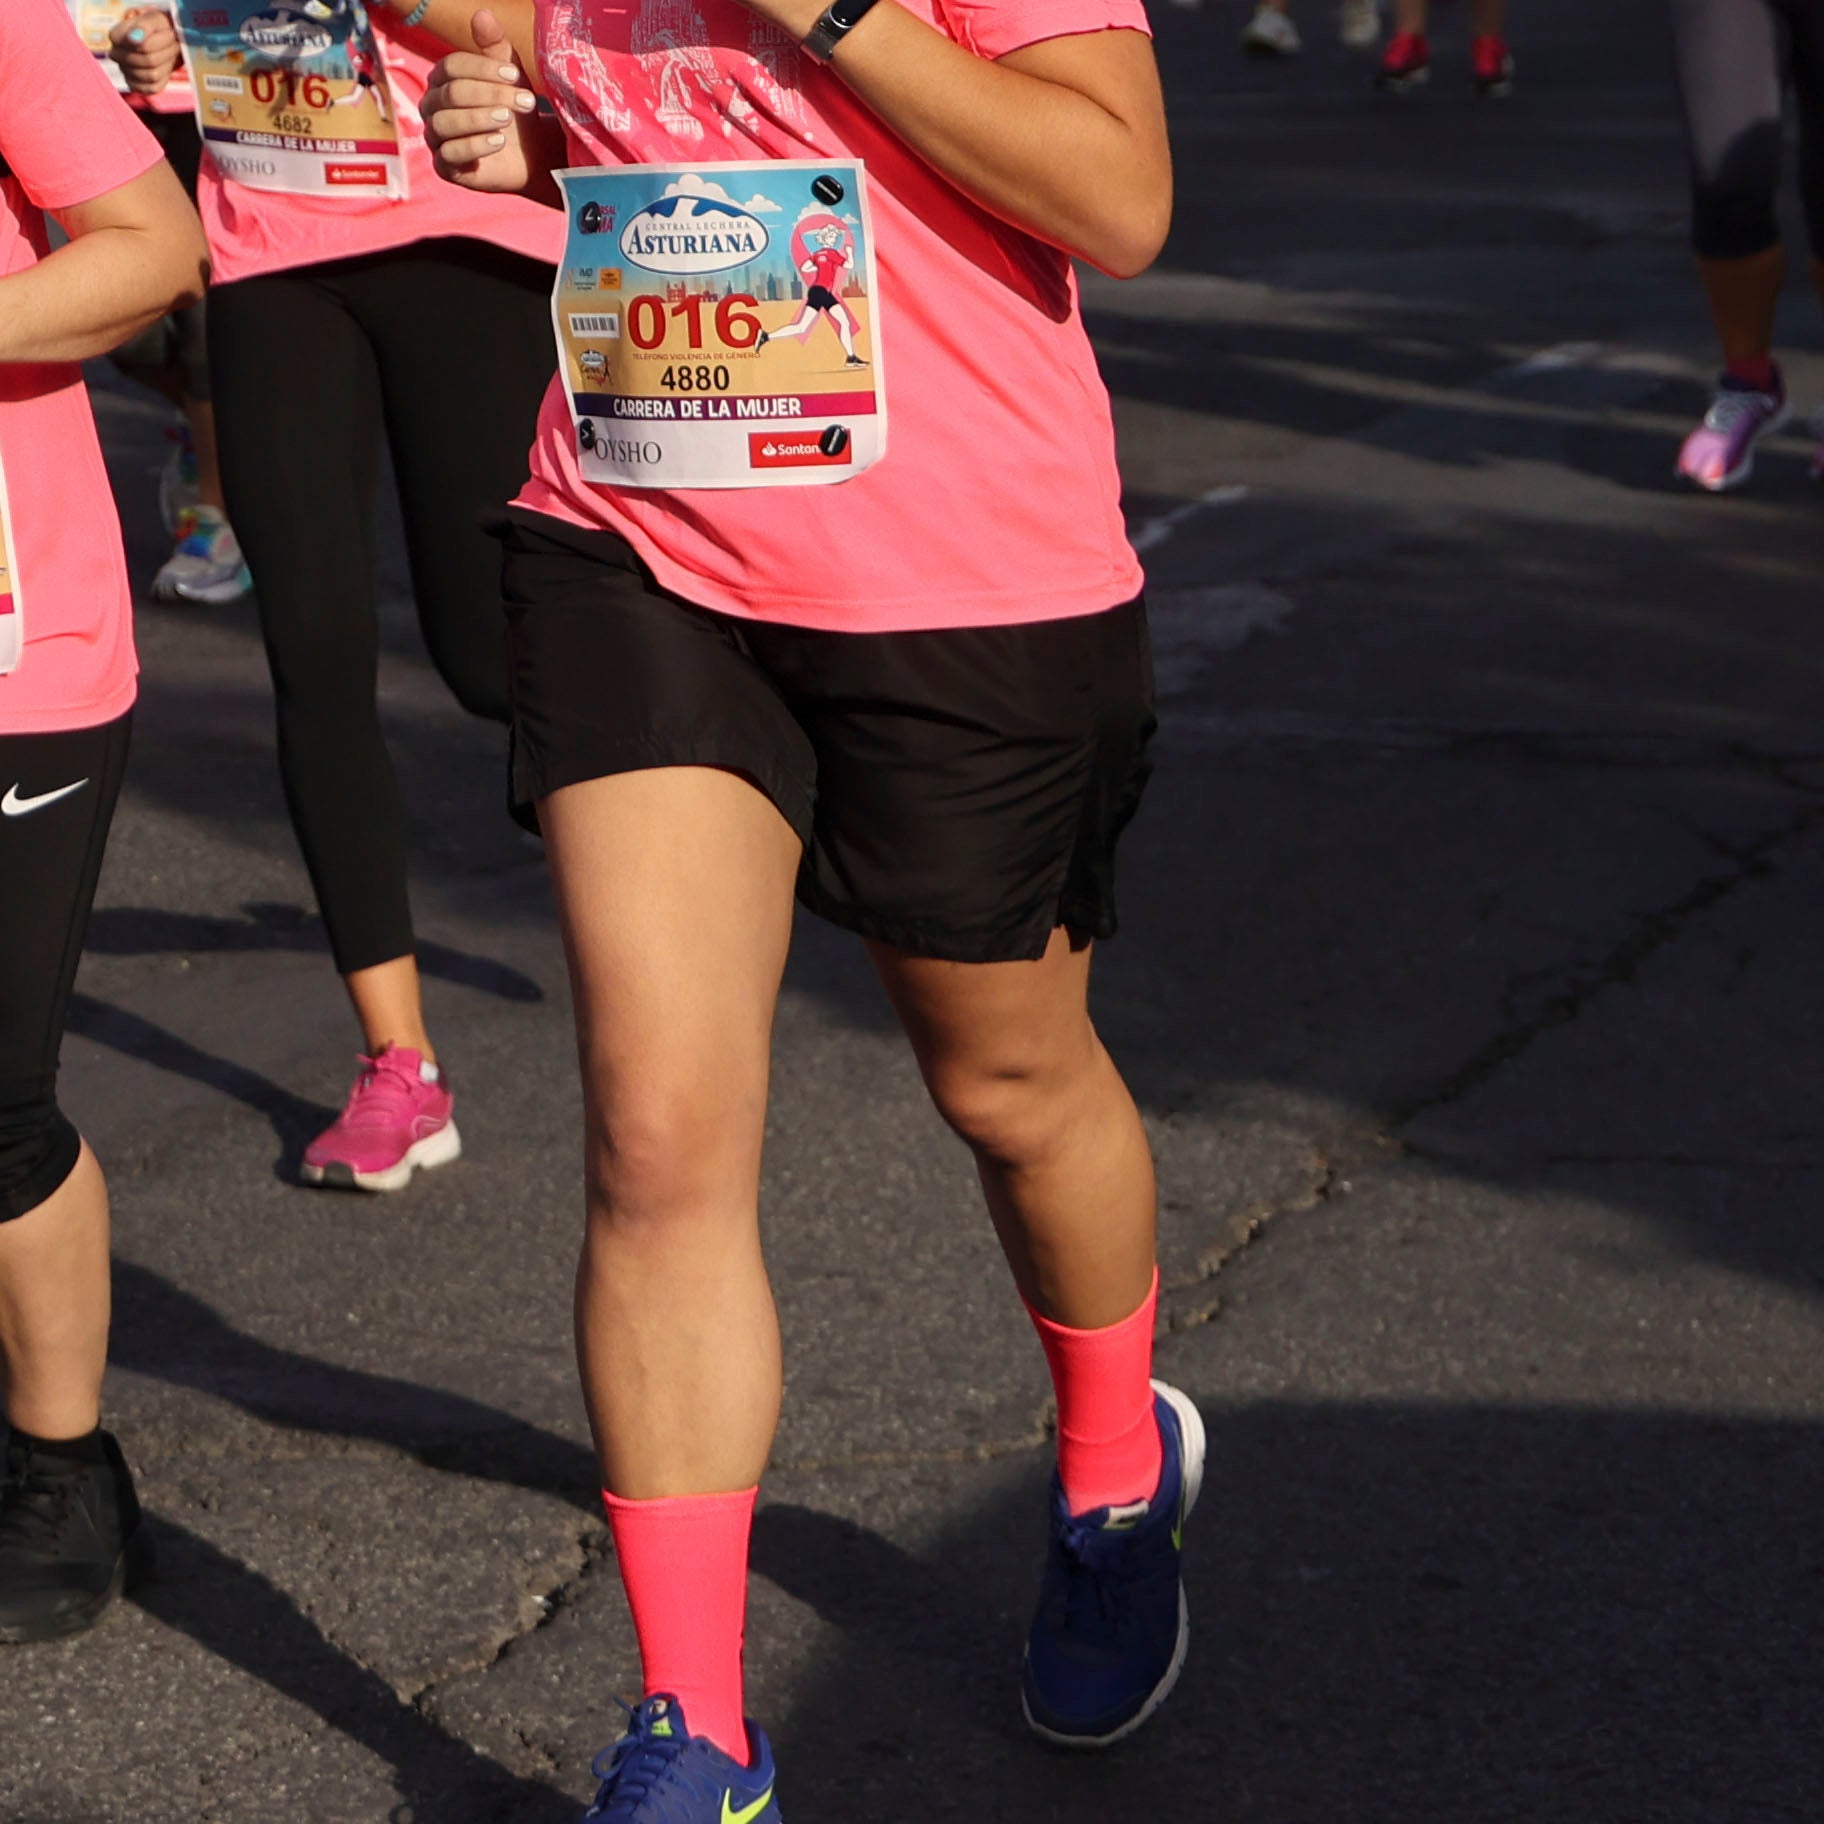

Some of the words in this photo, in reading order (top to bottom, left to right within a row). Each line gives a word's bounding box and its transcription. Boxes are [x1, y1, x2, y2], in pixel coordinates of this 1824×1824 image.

[250, 66, 330, 108] 016
[272, 115, 312, 134] 4682
[627, 225, 757, 256] ASTURIANA
[628, 293, 762, 350] 016
[661, 364, 730, 391] 4880
[613, 398, 675, 418] CARRERA
[677, 400, 703, 418] DE
[708, 400, 731, 418] LA
[736, 397, 802, 417] MUJER
[594, 437, 662, 465] OYSHO
